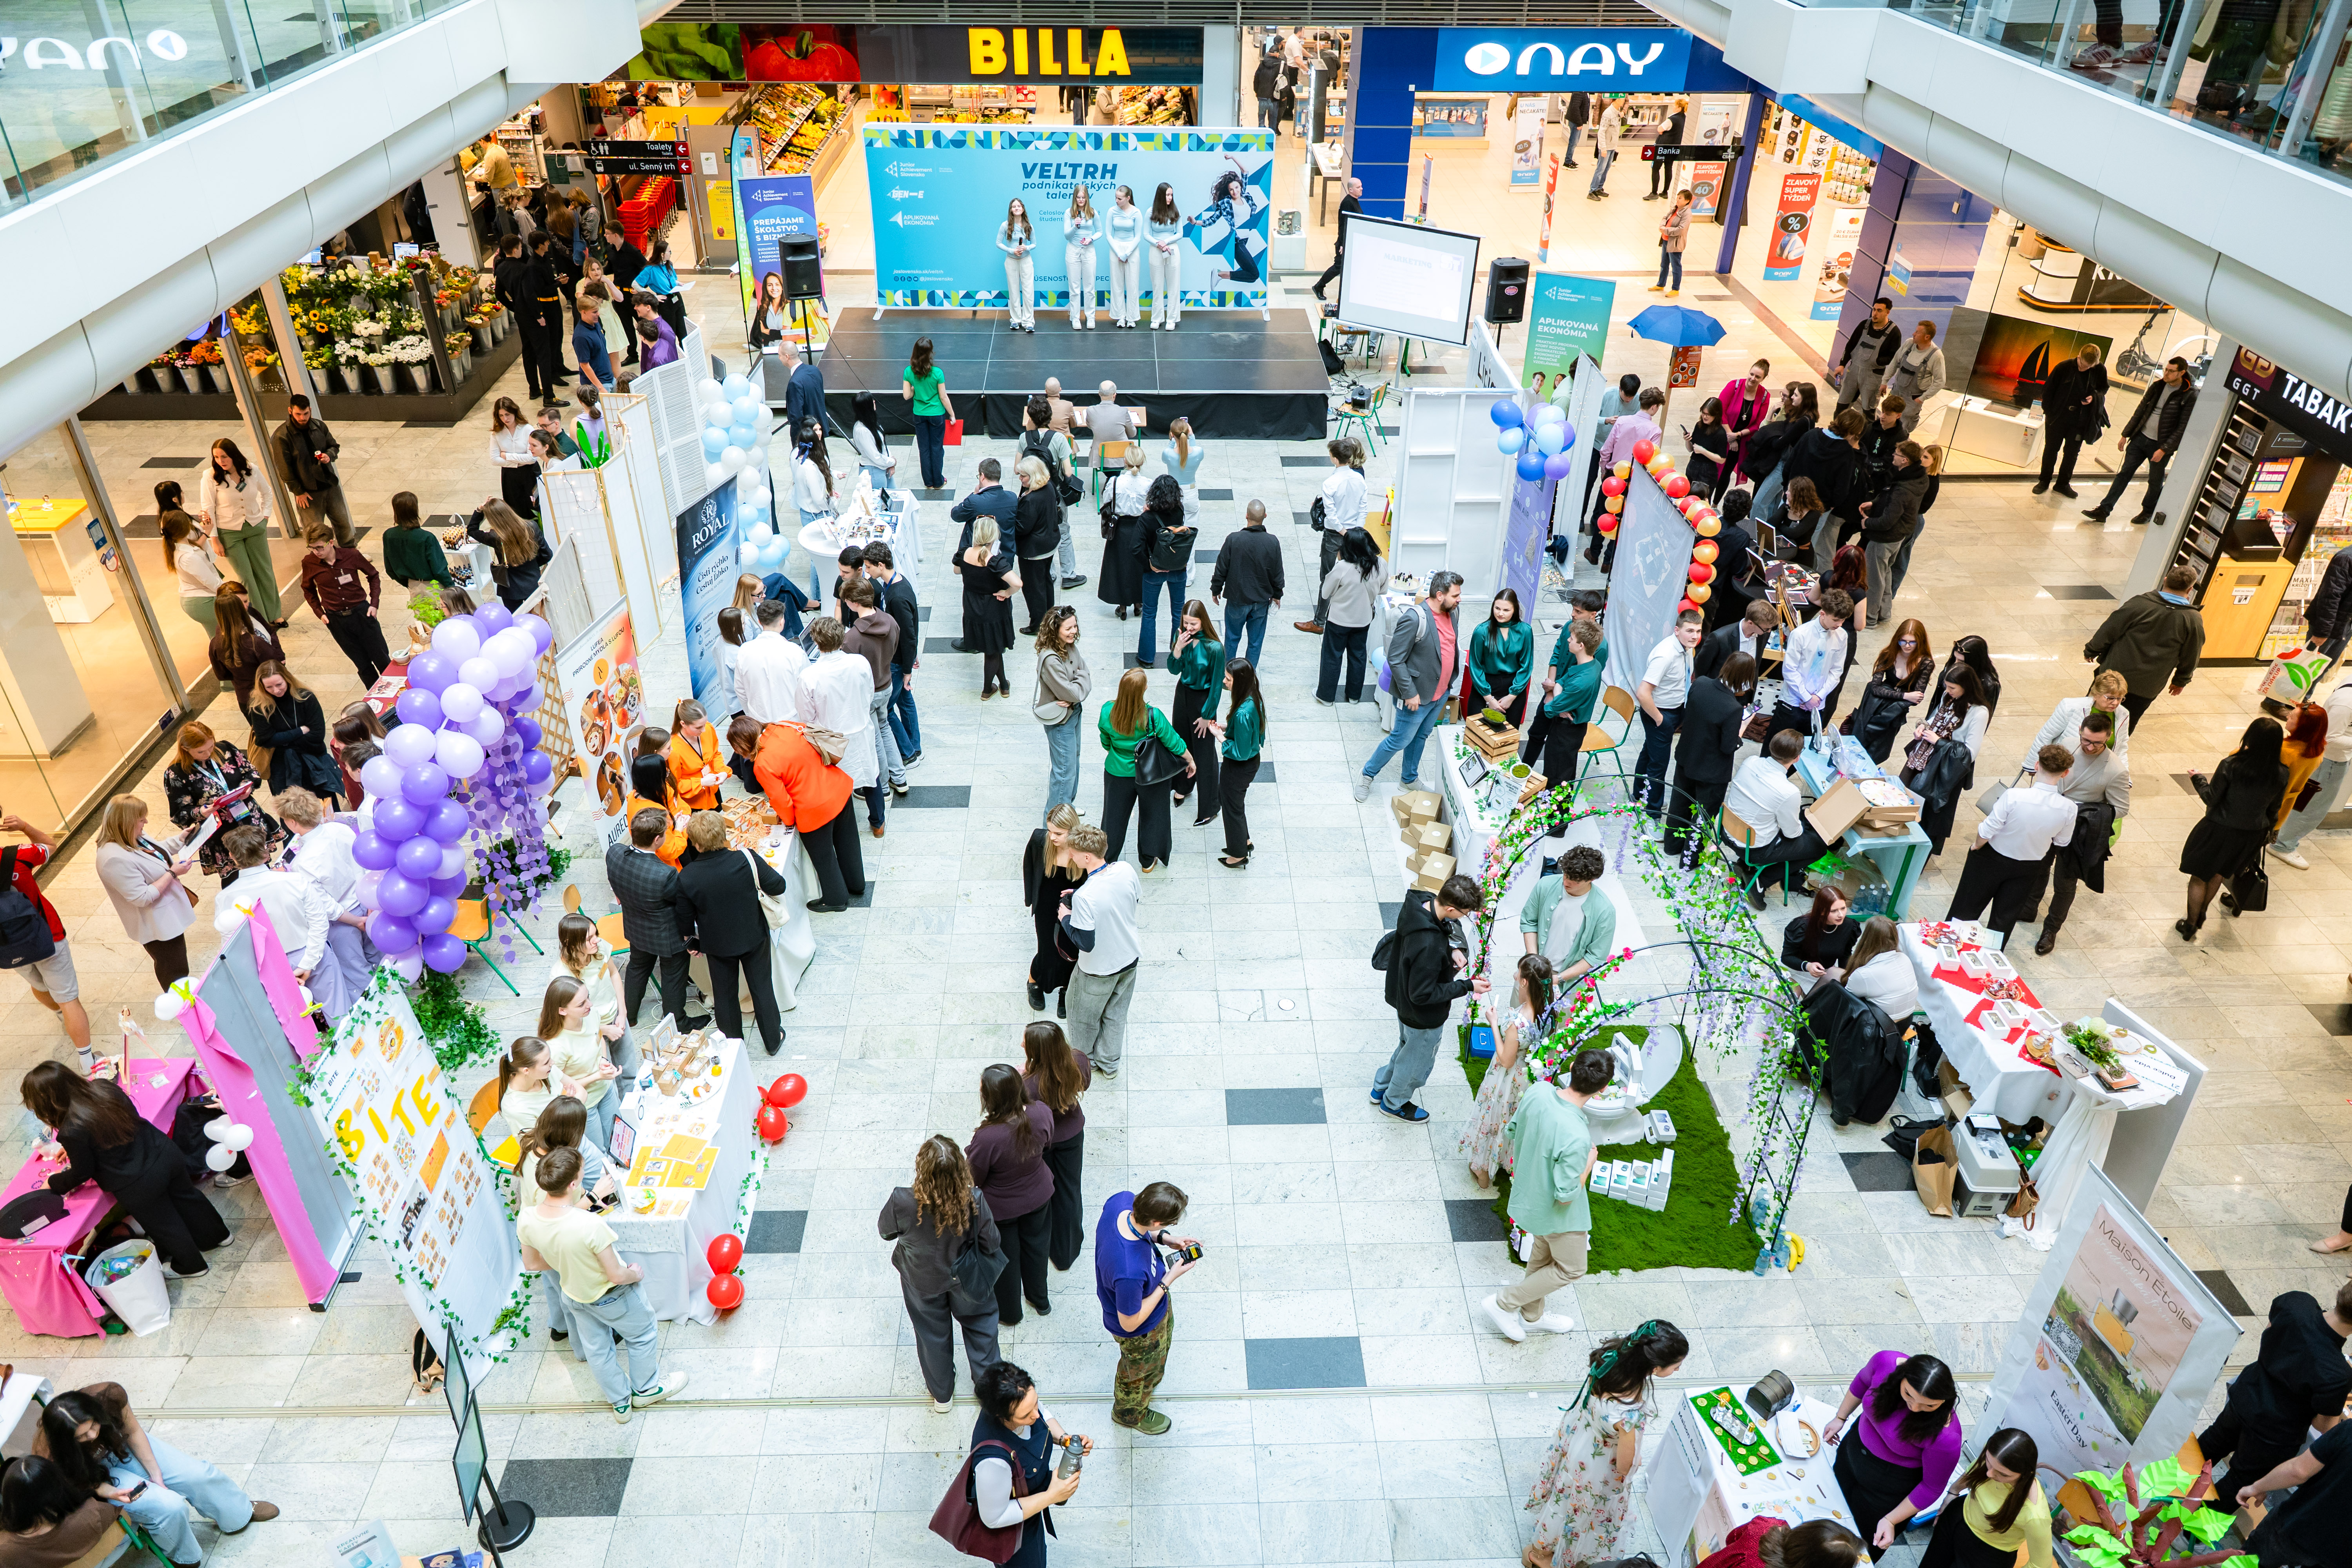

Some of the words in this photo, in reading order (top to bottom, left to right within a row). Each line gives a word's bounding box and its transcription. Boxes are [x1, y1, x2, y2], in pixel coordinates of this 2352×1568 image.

[969, 27, 1131, 75] BILLA
[646, 143, 671, 152] Toalety
[641, 162, 662, 171] Senný
[1021, 162, 1118, 180] VEĽTRH
[753, 217, 804, 226] PREPÁJAME
[755, 225, 798, 234] ŠKOLSTVO
[1788, 217, 1800, 230] %
[1384, 253, 1432, 269] MARKETING
[1537, 325, 1587, 338] EKONÓMIA
[1538, 317, 1599, 331] APLIKOVANÁ
[2232, 377, 2260, 400] GGT
[1512, 495, 1522, 513] MINI
[691, 512, 730, 549] ROYAL
[705, 539, 714, 547] pastou
[711, 555, 728, 572] rýchlo
[696, 577, 713, 594] Cestuj
[713, 566, 728, 581] ľahko
[1510, 564, 1521, 581] DIAMOND
[1521, 578, 1531, 596] ESSENCE
[590, 637, 604, 651] LUFEA
[593, 642, 608, 657] MYDLA
[612, 626, 624, 641] LUFOU
[2269, 667, 2281, 687] NÁKUP
[708, 685, 717, 695] ZISTI
[353, 1040, 363, 1054] BITE
[2134, 1059, 2151, 1069] vida
[328, 1070, 339, 1087] BITE
[2153, 1068, 2176, 1079] Dulce
[334, 1074, 440, 1163] BITE
[446, 1112, 455, 1125] BITE
[658, 1203, 668, 1214] BITE
[2099, 1220, 2150, 1281] Maison
[2151, 1279, 2192, 1330] Étoile
[2083, 1366, 2105, 1394] prvom
[2051, 1390, 2073, 1425] Easter
[2071, 1424, 2087, 1448] Day
[1678, 1411, 1690, 1439] Maison
[1690, 1438, 1699, 1462] Étoile
[1713, 1490, 1729, 1531] Maison
[336, 1529, 370, 1549] KREATÍVNE
[339, 1540, 358, 1553] KARTY
